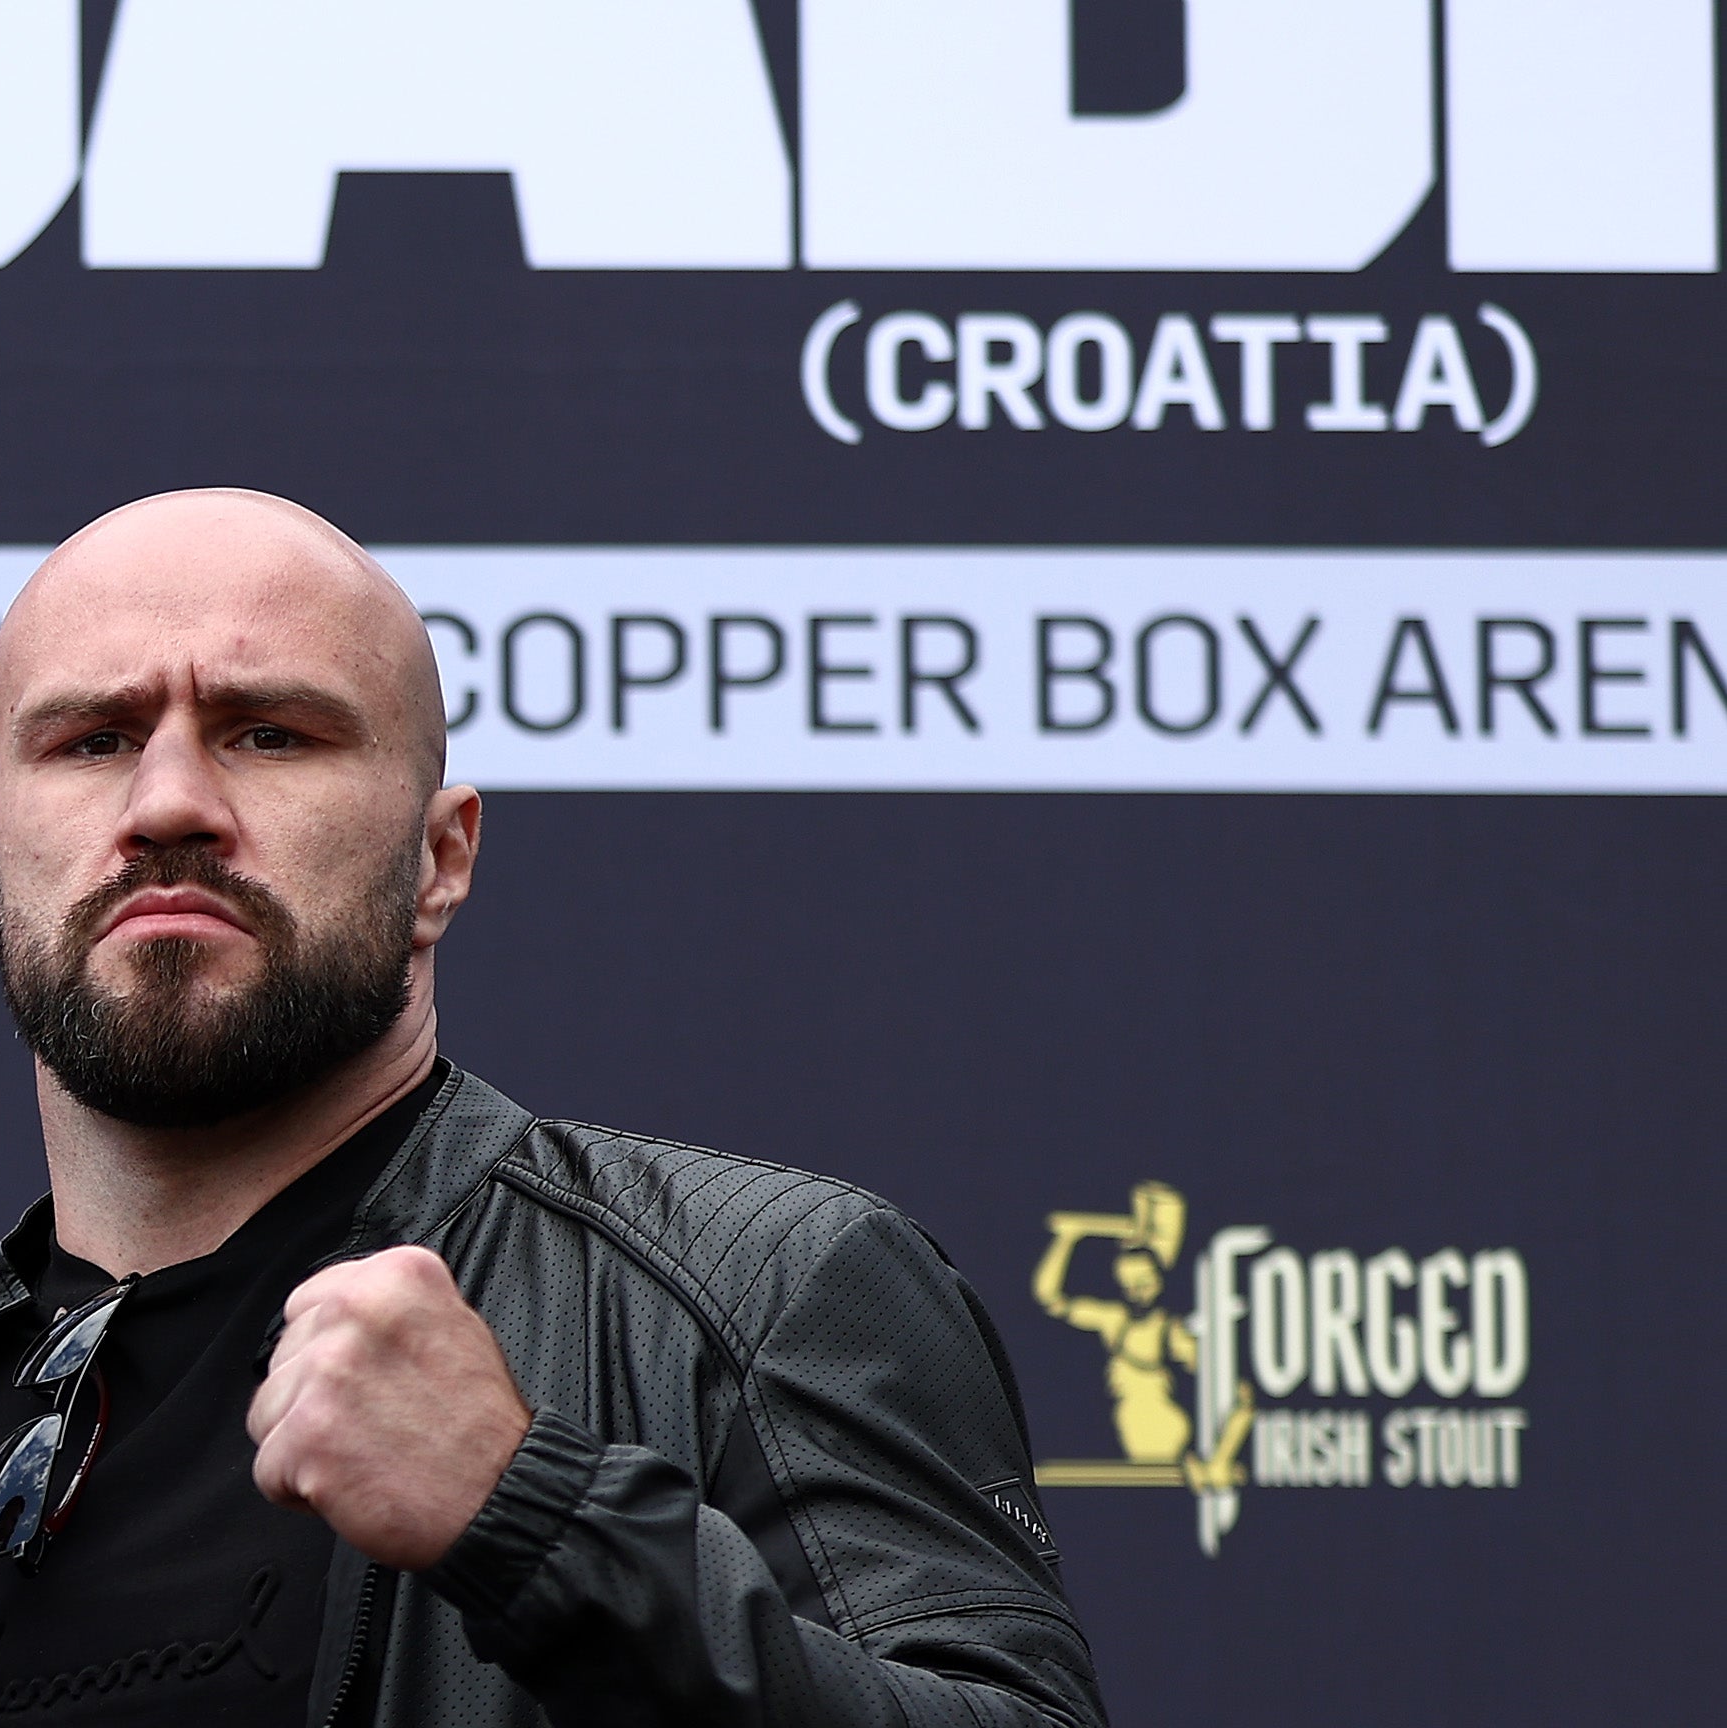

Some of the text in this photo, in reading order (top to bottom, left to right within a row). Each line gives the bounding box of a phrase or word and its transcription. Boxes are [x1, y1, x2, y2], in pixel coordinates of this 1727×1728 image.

[801, 302, 1538, 447] (CROATIA)
[1034, 611, 1322, 736] BOX
[1193, 1225, 1530, 1465] FORGED
[1254, 1407, 1526, 1488] IRISH STOUT
